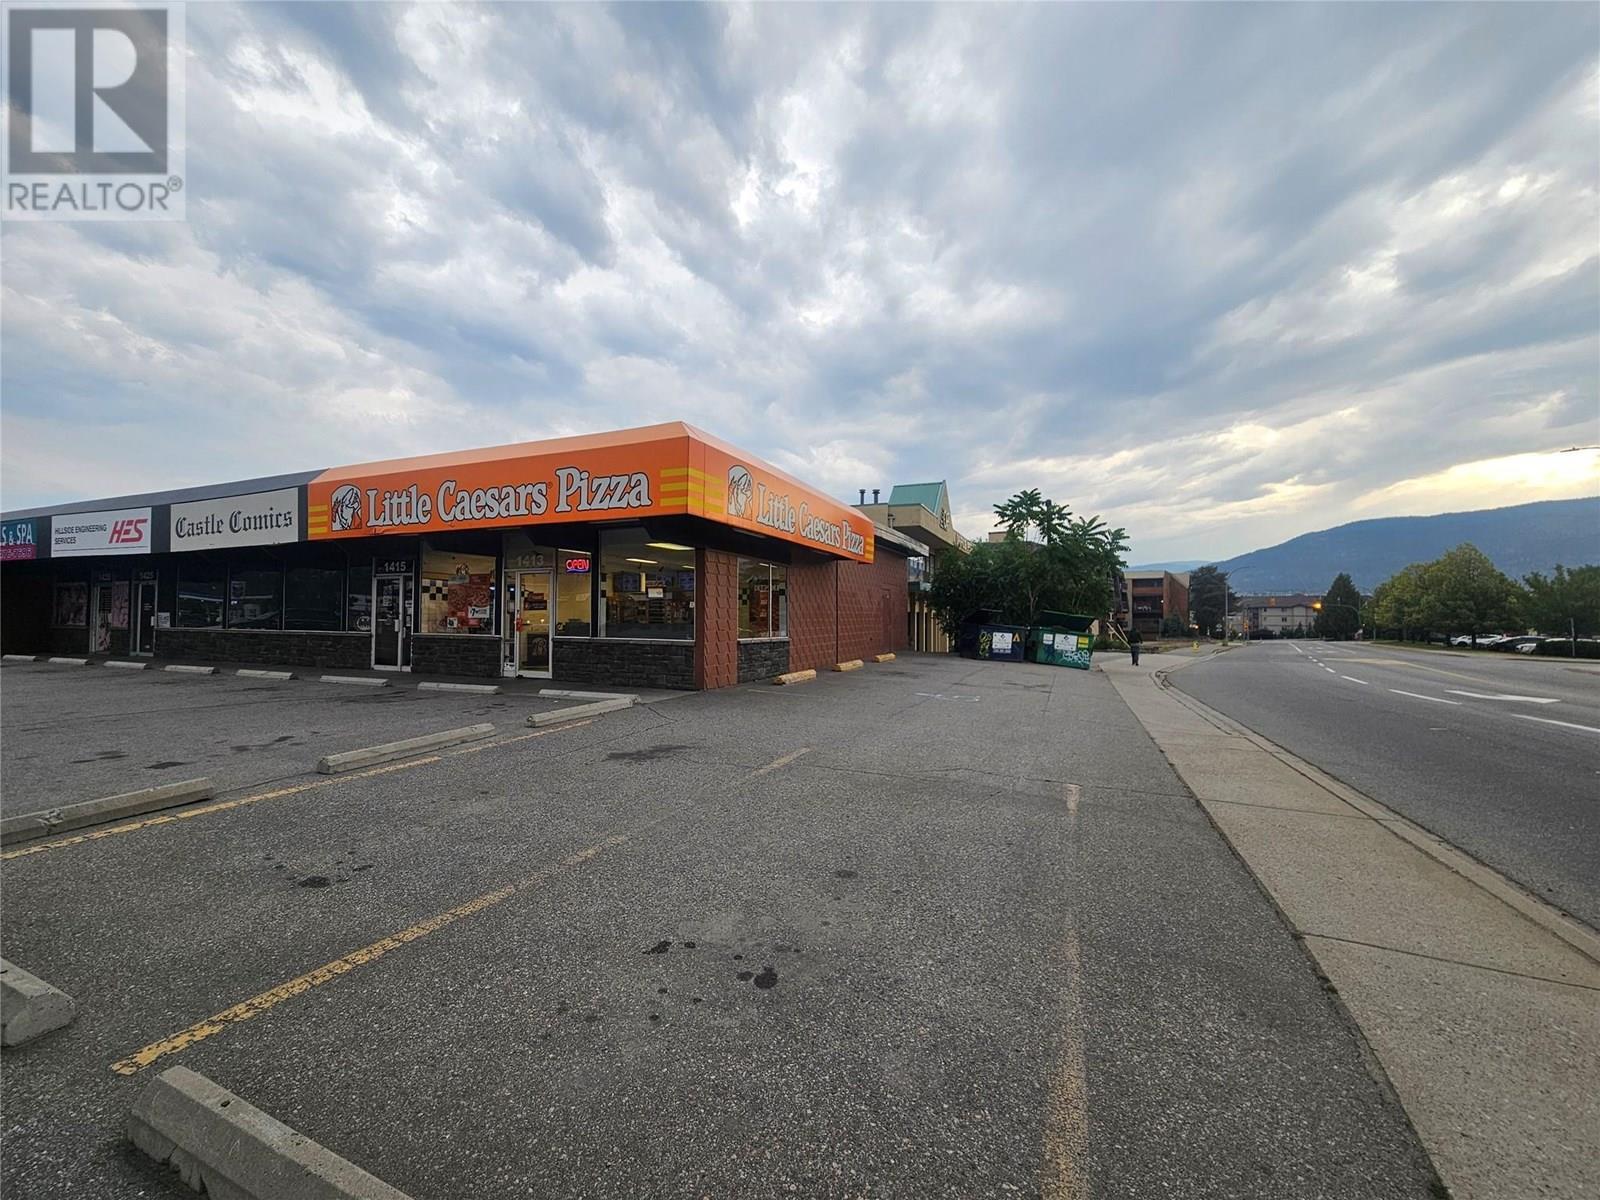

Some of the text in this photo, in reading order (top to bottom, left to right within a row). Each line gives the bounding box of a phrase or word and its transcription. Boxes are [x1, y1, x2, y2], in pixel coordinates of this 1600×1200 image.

[366, 465, 652, 528] Little Caesars Pizza
[54, 523, 108, 535] HILLSIDE ENGINEERING
[175, 506, 293, 538] Castle Comics
[757, 482, 865, 556] Little Caesars Pizza
[16, 523, 33, 545] SPA
[54, 536, 77, 545] SERVICES
[108, 518, 149, 544] HES
[383, 560, 407, 573] 1415
[565, 559, 590, 570] OPEN
